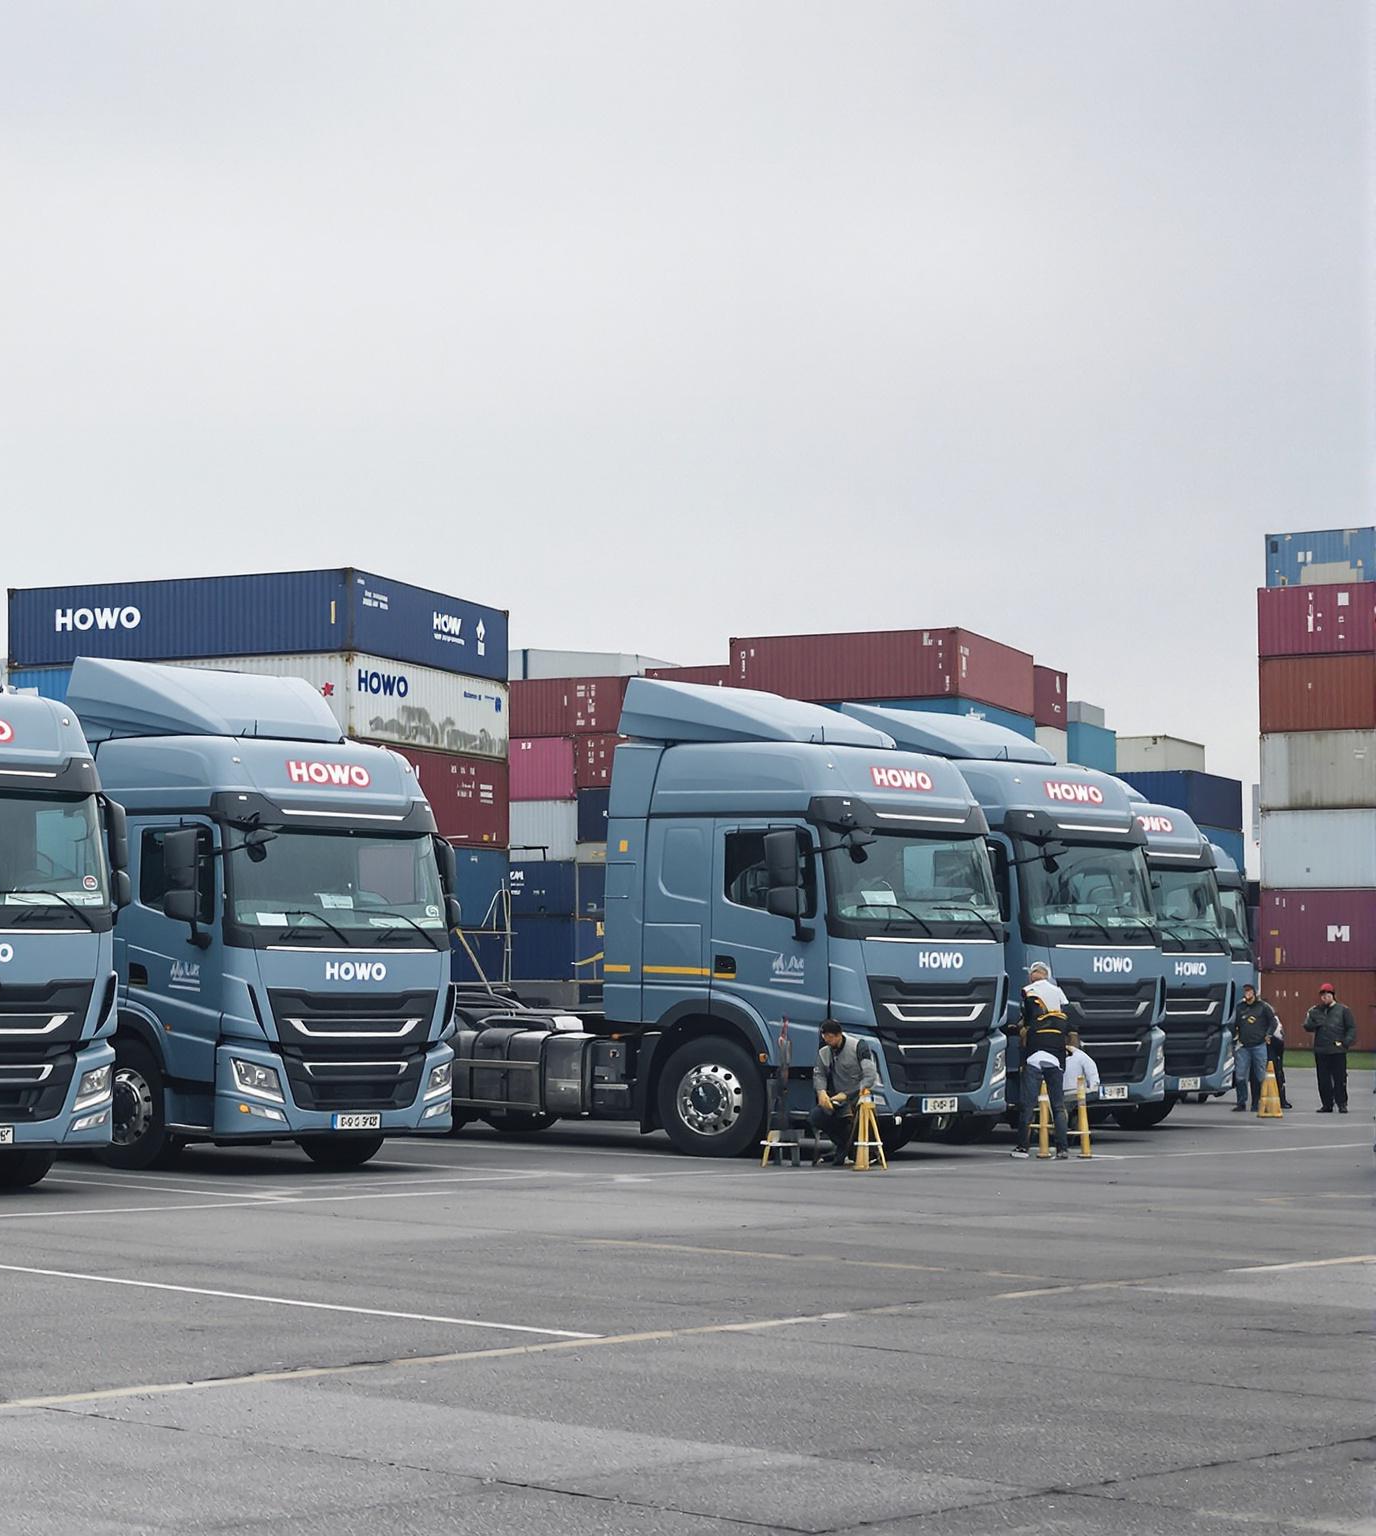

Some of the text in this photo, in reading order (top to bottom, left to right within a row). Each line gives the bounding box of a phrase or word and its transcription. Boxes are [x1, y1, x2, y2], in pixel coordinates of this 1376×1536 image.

[55, 606, 141, 632] HOWO
[358, 669, 409, 698] HOWO
[289, 760, 371, 786] HOWO
[872, 767, 933, 790] HOWO
[1045, 782, 1104, 804] HOWO
[1327, 925, 1350, 942] M
[918, 951, 964, 969] HOWO
[1092, 956, 1133, 973] HOWO
[1174, 962, 1207, 976] HOWO
[325, 961, 387, 981] HOWO
